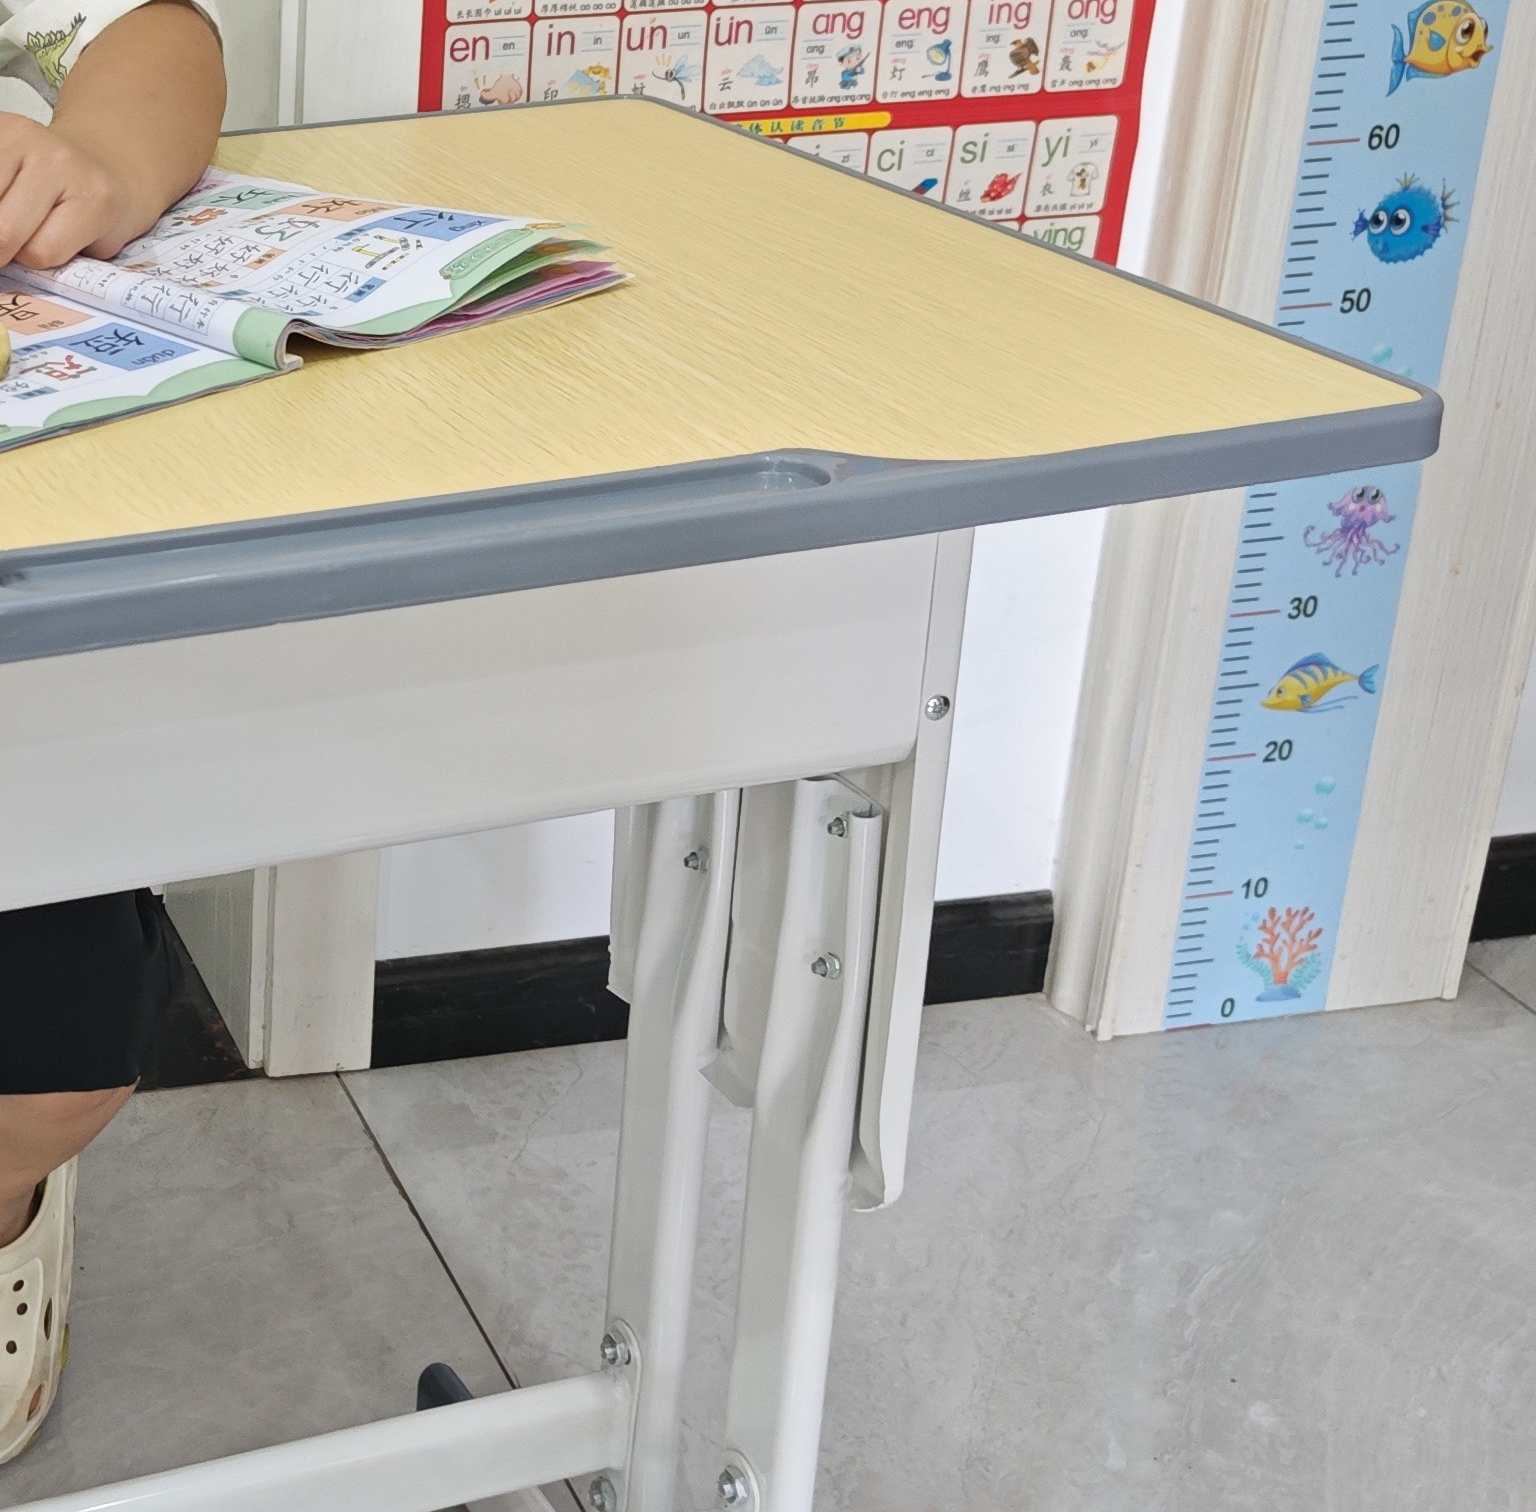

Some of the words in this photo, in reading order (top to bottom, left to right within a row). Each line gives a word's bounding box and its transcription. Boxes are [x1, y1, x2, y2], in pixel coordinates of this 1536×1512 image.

[714, 16, 753, 47] ün
[812, 10, 865, 40] ang
[898, 5, 951, 35] eng
[449, 35, 490, 62] en
[546, 24, 576, 56] in
[626, 24, 667, 51] un
[718, 76, 733, 91] 云
[736, 116, 846, 135] 体认读音节
[1367, 123, 1400, 151] 60
[876, 140, 906, 172] ci
[960, 132, 989, 165] si
[1041, 127, 1070, 168] yi
[1339, 288, 1371, 314] 50
[69, 328, 145, 356] 短
[1287, 595, 1318, 620] 30
[1262, 739, 1293, 763] 20
[1241, 876, 1269, 899] 10
[1220, 997, 1235, 1018] 0
